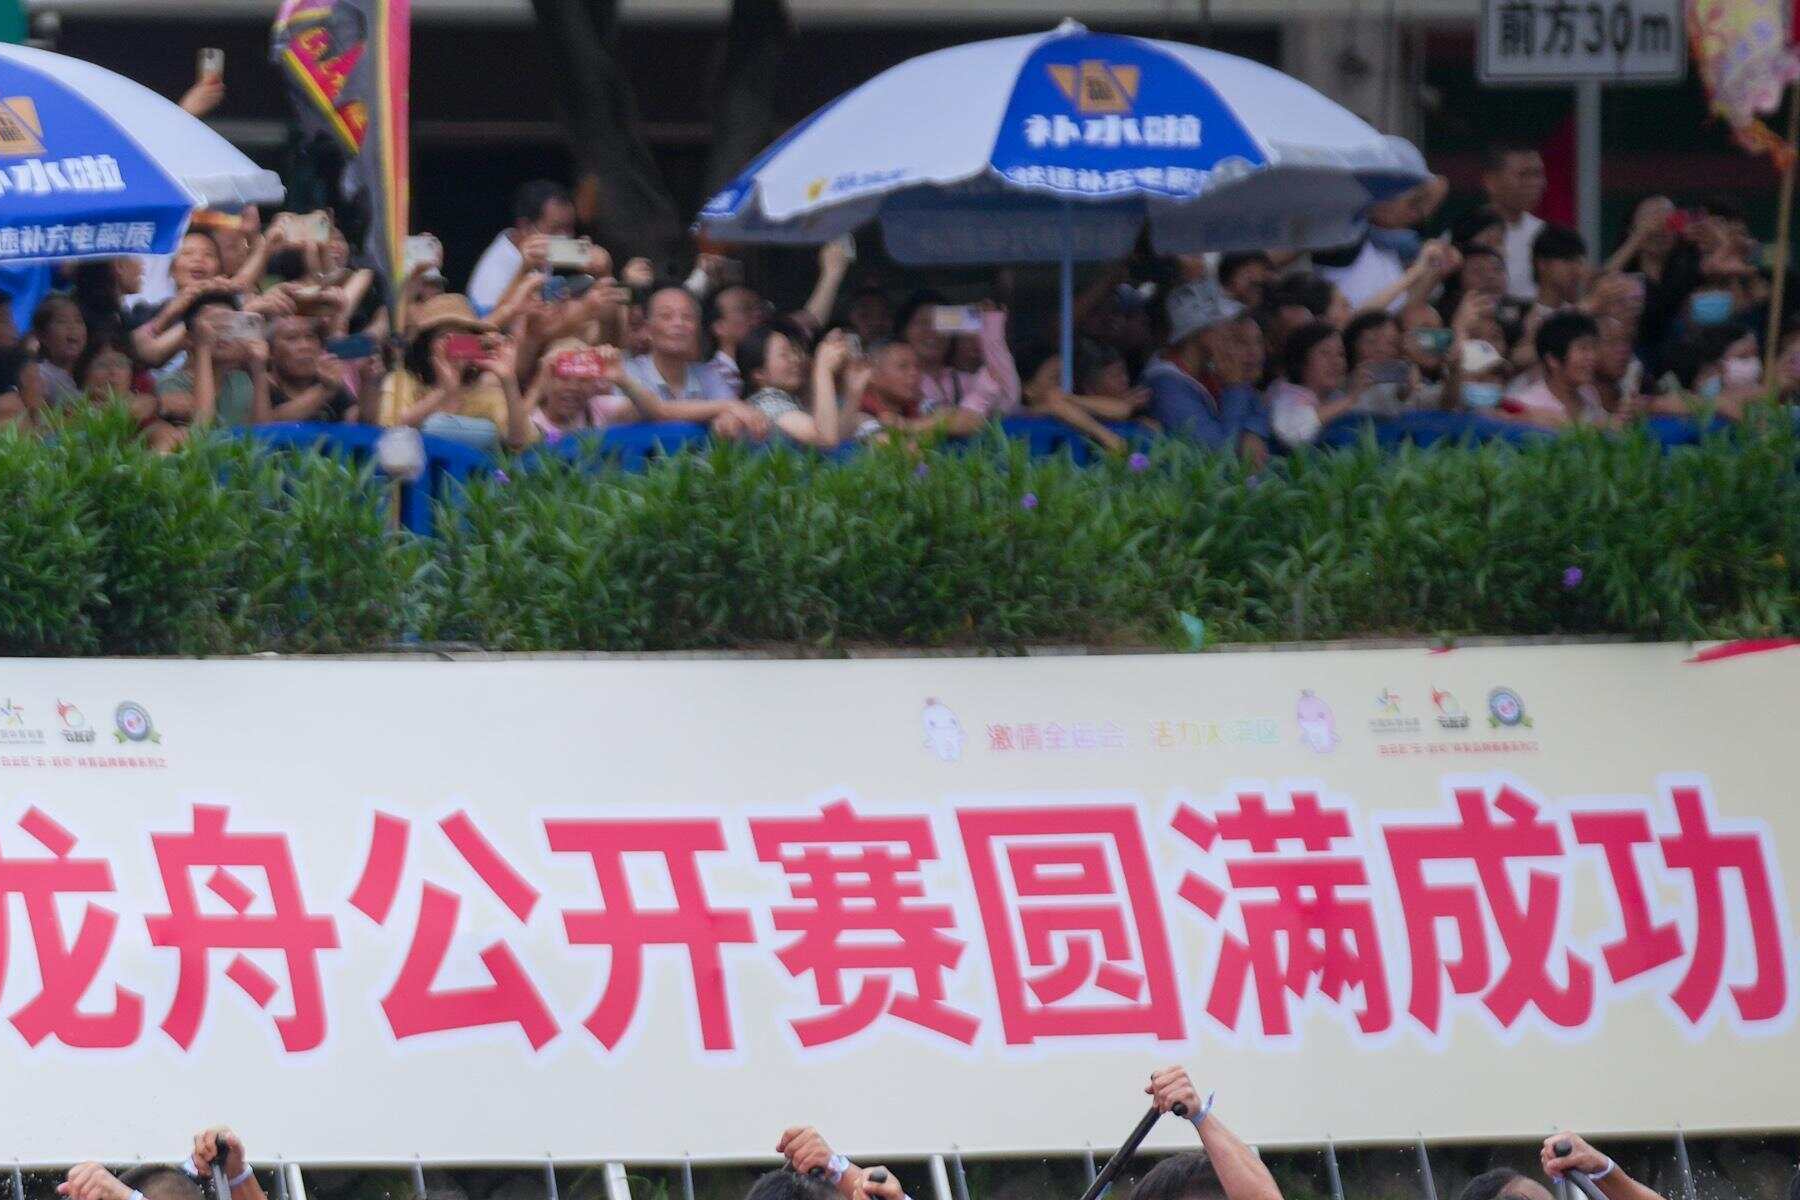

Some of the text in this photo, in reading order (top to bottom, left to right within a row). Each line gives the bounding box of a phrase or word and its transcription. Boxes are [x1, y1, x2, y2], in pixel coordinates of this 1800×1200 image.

[1499, 1, 1672, 56] 前方30m
[1024, 114, 1201, 148] 补水啦
